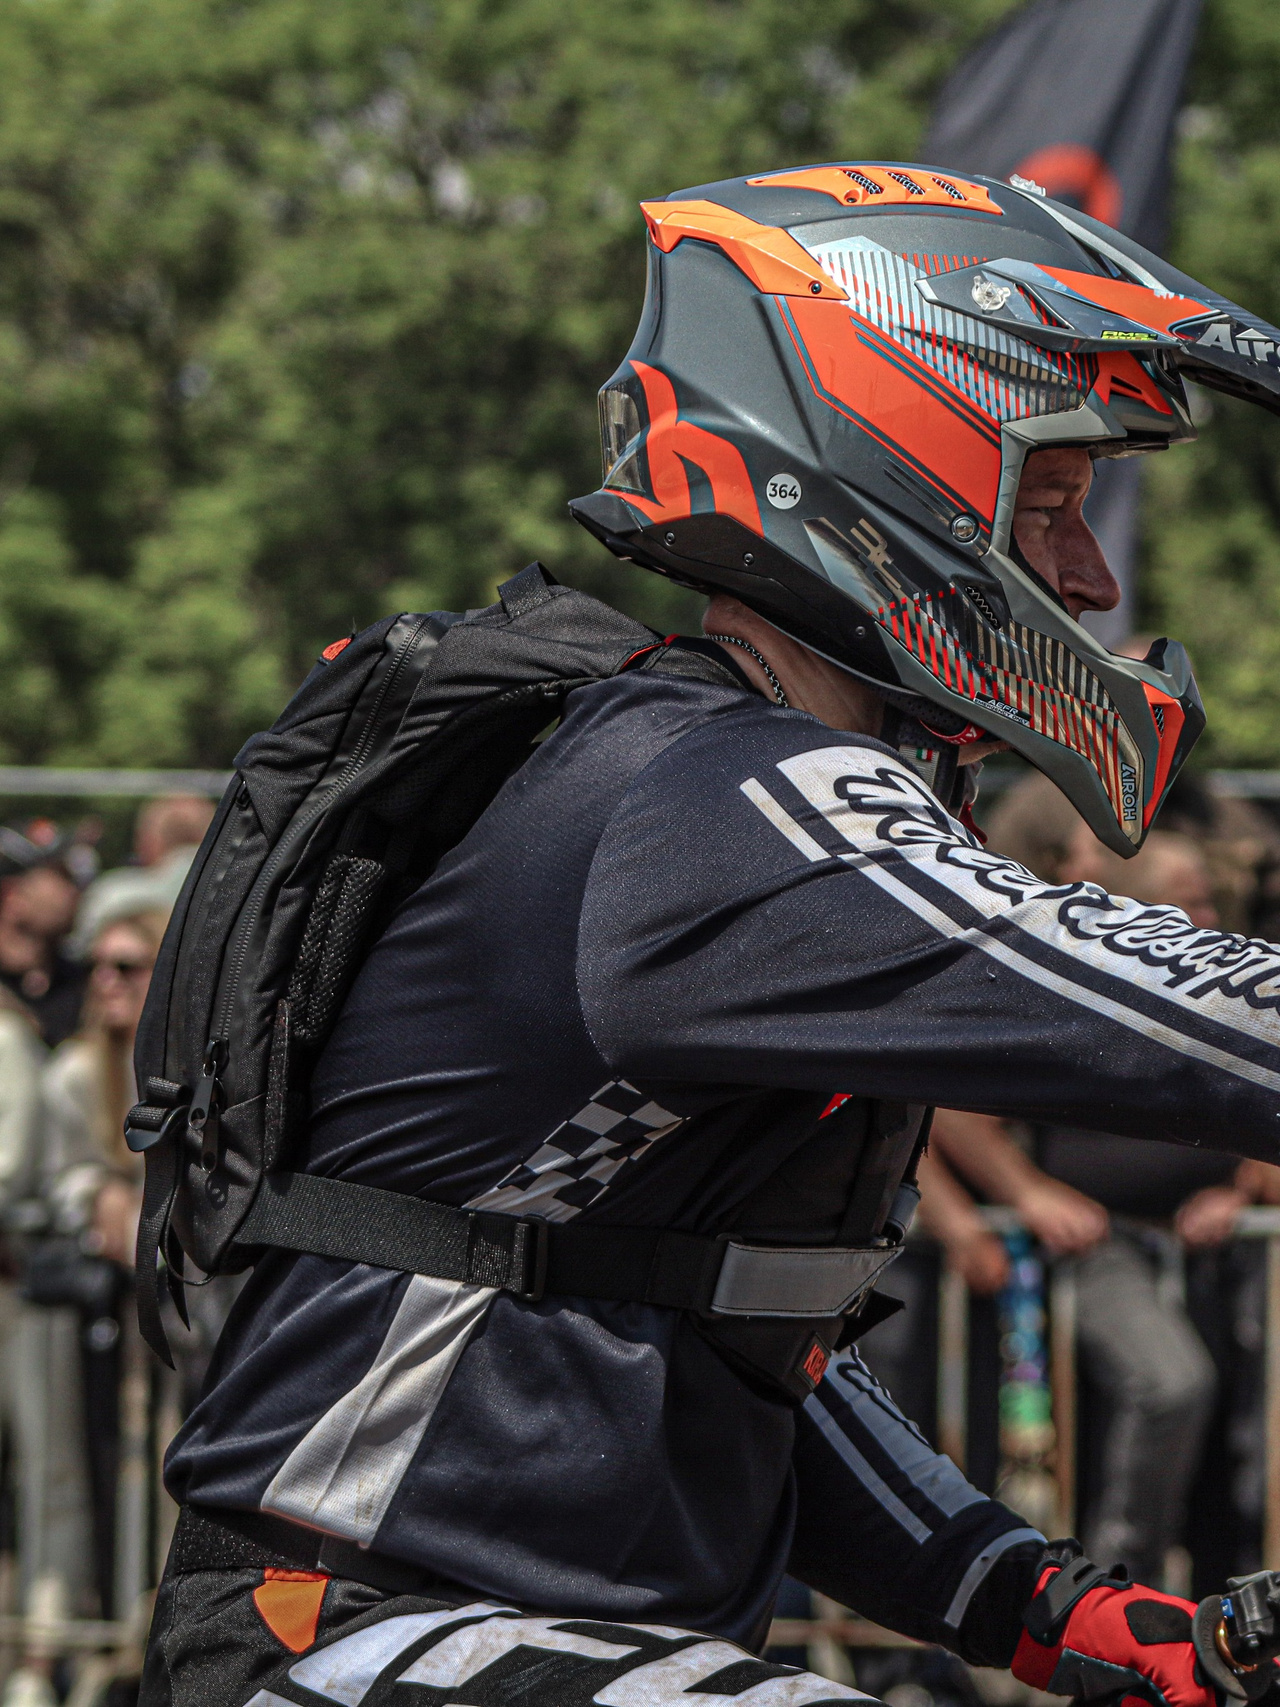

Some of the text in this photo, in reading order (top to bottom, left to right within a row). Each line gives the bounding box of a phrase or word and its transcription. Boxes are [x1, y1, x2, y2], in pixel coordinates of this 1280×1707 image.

[768, 483, 799, 500] 364
[987, 698, 1019, 715] AEFR
[1121, 762, 1137, 822] AIROH
